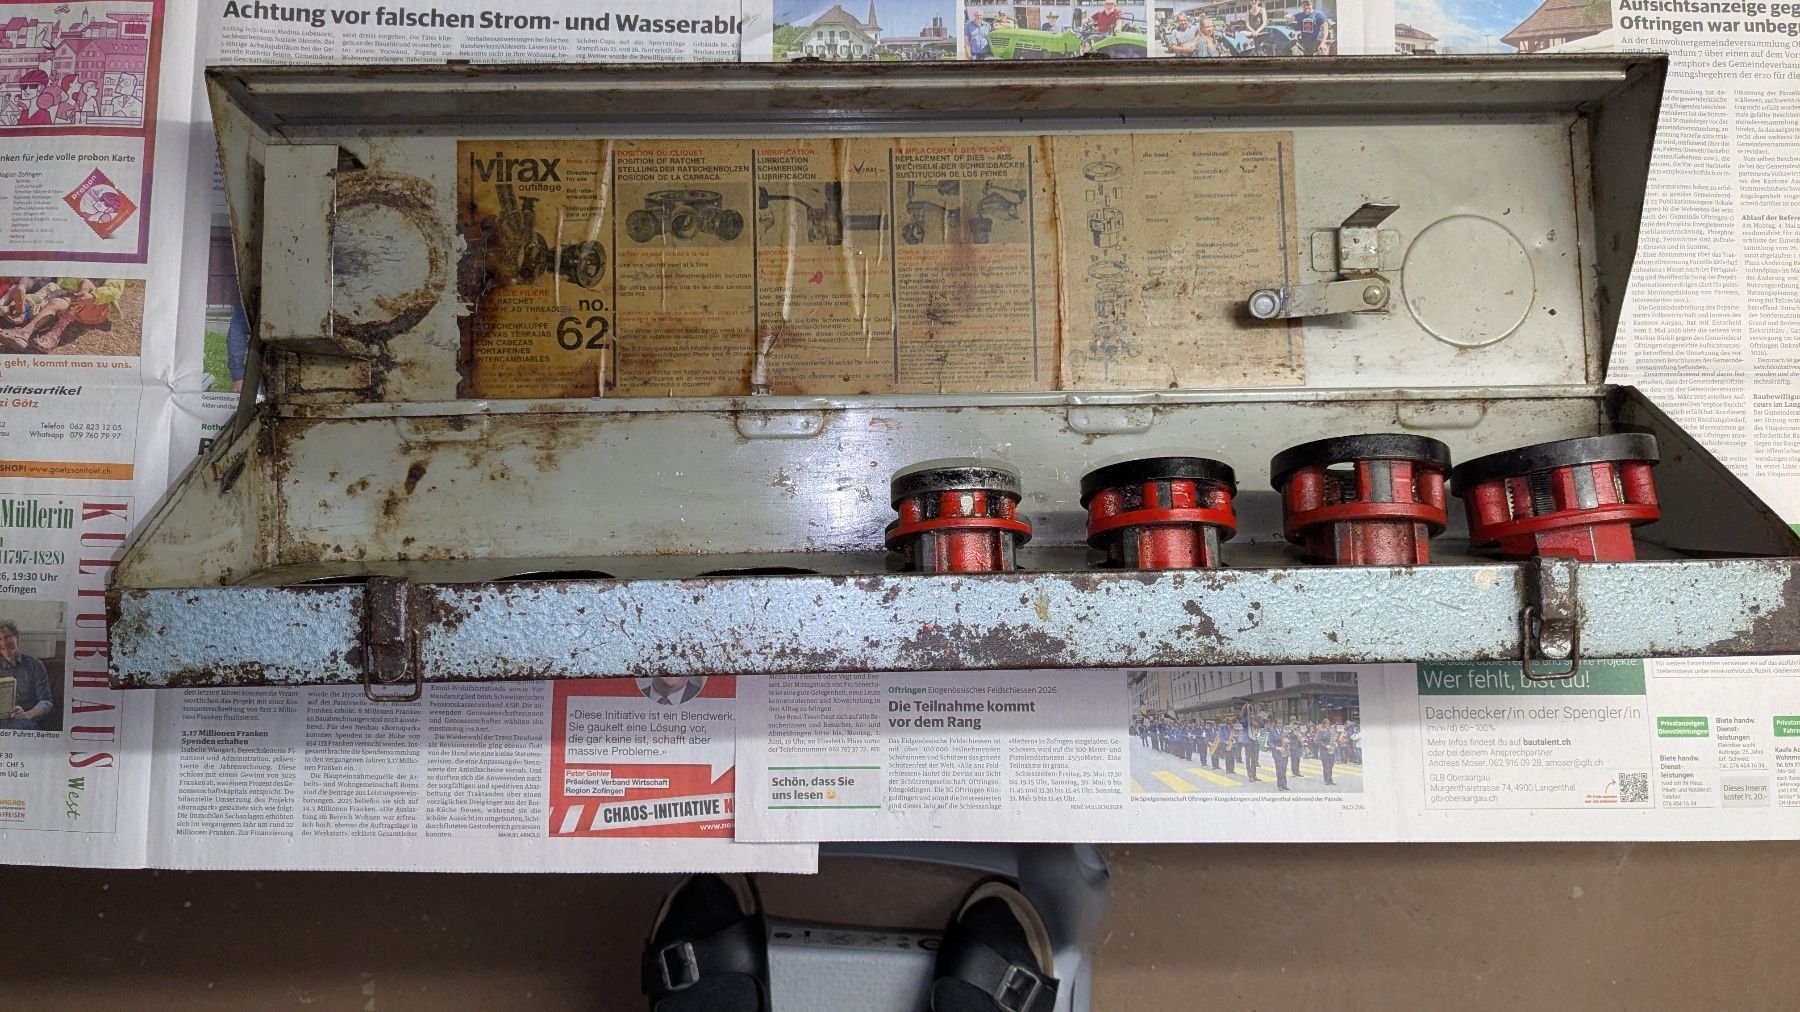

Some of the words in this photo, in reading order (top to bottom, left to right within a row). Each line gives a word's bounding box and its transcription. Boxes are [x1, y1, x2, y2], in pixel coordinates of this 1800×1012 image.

[1619, 0, 1767, 17] Aufsichtsanzeige
[223, 0, 325, 27] Achtung
[331, 10, 371, 25] vor
[376, 7, 475, 28] falschen
[479, 11, 560, 30] Strom-
[565, 12, 610, 31] und
[1620, 16, 1703, 34] Oftringen
[1707, 21, 1741, 32] war
[1744, 19, 1800, 36] unbeg
[1621, 37, 1633, 45] An
[1635, 37, 1649, 45] der
[22, 153, 34, 162] für
[35, 153, 54, 163] jede
[56, 153, 76, 161] volle
[78, 153, 110, 163] probon
[112, 154, 136, 163] Karte
[474, 151, 562, 183] virax
[677, 165, 750, 173] RATSCHENBOLZEN
[895, 163, 938, 171] WECHSELN
[960, 162, 1025, 170] SCHNEIDBACKEN
[18, 171, 43, 179] Zofingen
[896, 171, 947, 179] SUSTITUCION
[578, 298, 609, 312] no.
[557, 315, 610, 351] 62
[4, 358, 30, 369] geht,
[32, 358, 68, 368] kommt
[71, 360, 93, 368] man
[97, 361, 109, 369] zu
[111, 361, 132, 369] uns.
[12, 399, 39, 408] Götz
[41, 422, 65, 430] Telefon
[29, 431, 65, 440] Whatsapp
[0, 464, 27, 473] SHOP!
[0, 498, 74, 529] Müllerin
[12, 572, 38, 581] 19:30
[40, 572, 58, 581] Uhr
[1423, 669, 1460, 688] Wer
[1467, 669, 1515, 691] fehlt,
[888, 686, 927, 696] Oftringen
[928, 686, 986, 696] Eidgenössisches
[987, 686, 1037, 694] Feldschiessen
[1038, 686, 1057, 694] 2026
[888, 700, 912, 712] Die
[914, 700, 985, 712] Teilnahme
[987, 700, 1036, 712] kommt
[569, 710, 602, 720] «Diese
[605, 710, 645, 720] Initiative
[649, 711, 660, 720] ist
[664, 711, 678, 721] ein
[681, 711, 736, 722] Blendwerk.
[1425, 706, 1525, 721] Dachdecker/in
[1528, 706, 1559, 720] oder
[1563, 706, 1641, 723] Spengler/in
[888, 718, 912, 728] vor
[914, 716, 944, 728] dem
[947, 716, 982, 730] Rang
[1426, 723, 1458, 733] (m/w/d)
[1660, 720, 1705, 728] Privatanzeigen
[198, 729, 235, 737] Millionen
[568, 722, 585, 732] Sie
[587, 722, 624, 735] gaukelt
[626, 723, 647, 732] eine
[650, 722, 687, 735] Lösung
[689, 725, 707, 734] vor,
[1658, 728, 1709, 736] Dienstleistungen
[568, 734, 584, 744] die
[584, 736, 602, 746] gar
[605, 734, 632, 744] keine
[634, 734, 649, 746] ist,
[652, 735, 686, 745] schafft
[688, 735, 711, 745] aber
[1427, 738, 1447, 746] Mehr
[1448, 738, 1468, 746] Infos
[1469, 738, 1497, 746] findest
[1499, 738, 1509, 746] du
[1509, 738, 1521, 746] auf
[1523, 738, 1572, 747] bautalent.ch
[1717, 734, 1751, 742] leistungen
[568, 746, 610, 756] massive
[611, 746, 668, 756] Probleme.»
[1427, 749, 1444, 757] oder
[1446, 749, 1460, 757] bei
[1461, 749, 1488, 757] deinem
[1489, 749, 1553, 759] Ansprechpartner
[1428, 758, 1460, 767] Andreas
[1461, 759, 1488, 768] Moser,
[1488, 759, 1504, 767] 062
[1505, 759, 1519, 767] 916
[1520, 759, 1531, 767] 09
[1545, 759, 1604, 769] amoser@glb.ch
[566, 770, 585, 778] Peter
[586, 770, 610, 778] Gehler
[1429, 773, 1445, 782] GLB
[1446, 773, 1491, 784] Oberaargau
[565, 778, 599, 786] Präsident
[632, 779, 668, 787] Wirtschaft
[772, 776, 809, 787] Schön,
[811, 776, 836, 786] dass
[837, 776, 855, 786] Sie
[565, 787, 591, 795] Region
[592, 787, 624, 795] Zofingen
[1430, 783, 1500, 793] Murgenthalstrasse
[1514, 783, 1534, 792] 4900
[1534, 783, 1576, 793] Langenthal
[1723, 784, 1745, 792] Dieses
[1745, 784, 1767, 792] Inserat
[66, 776, 85, 820] West
[772, 791, 792, 800] uns
[794, 789, 824, 800] lesen
[1430, 794, 1498, 803] glb-oberaargau.ch
[1723, 793, 1744, 801] kostet
[603, 799, 720, 824] CHAOS-INITIATIVE
